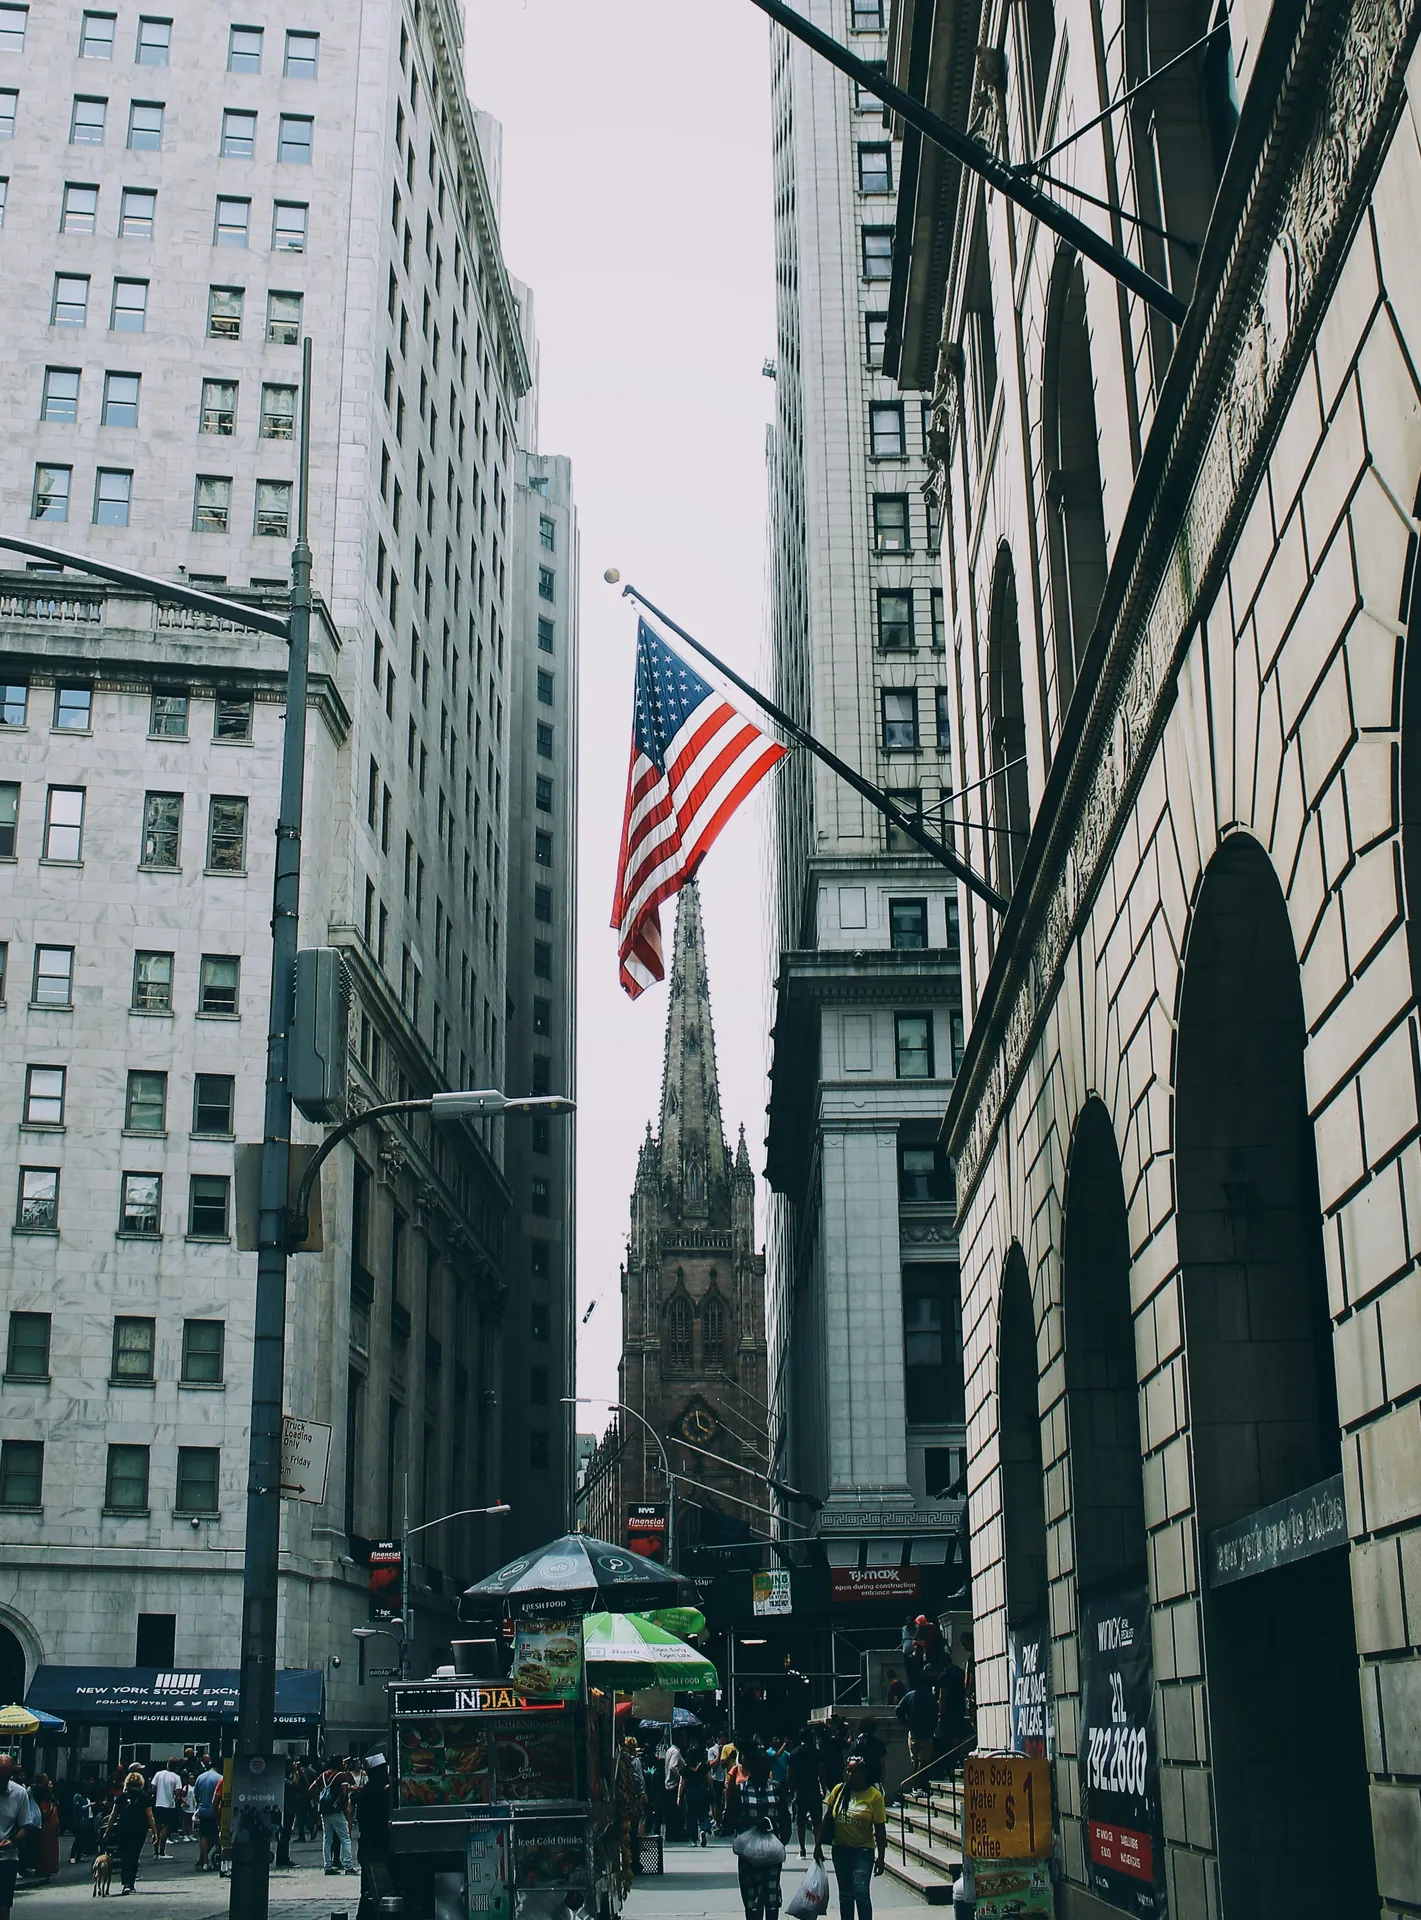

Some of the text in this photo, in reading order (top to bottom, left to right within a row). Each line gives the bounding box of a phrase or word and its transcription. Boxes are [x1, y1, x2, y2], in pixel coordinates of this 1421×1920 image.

[286, 1420, 305, 1431] Truck
[285, 1428, 313, 1443] Loading
[284, 1437, 300, 1449] Only
[290, 1455, 312, 1468] Friday
[628, 1517, 665, 1526] financial
[1265, 1508, 1304, 1564] sports
[371, 1551, 401, 1559] financial
[853, 1583, 874, 1591] during
[875, 1581, 917, 1590] construction
[522, 1600, 567, 1611] FRESH FOOD
[681, 1676, 700, 1685] FOOD
[113, 1686, 149, 1694] YORK
[153, 1688, 200, 1696] STOCK
[203, 1687, 240, 1695] EXCH
[1109, 1672, 1127, 1723] 212
[455, 1689, 528, 1711] INDIAN
[1087, 1727, 1148, 1796] 792.2600
[968, 1764, 1013, 1787] Can Soda
[970, 1788, 997, 1810] Water
[970, 1812, 988, 1834] Tea
[518, 1835, 584, 1847] Iced Cold Drinks
[970, 1834, 1001, 1857] Coffee
